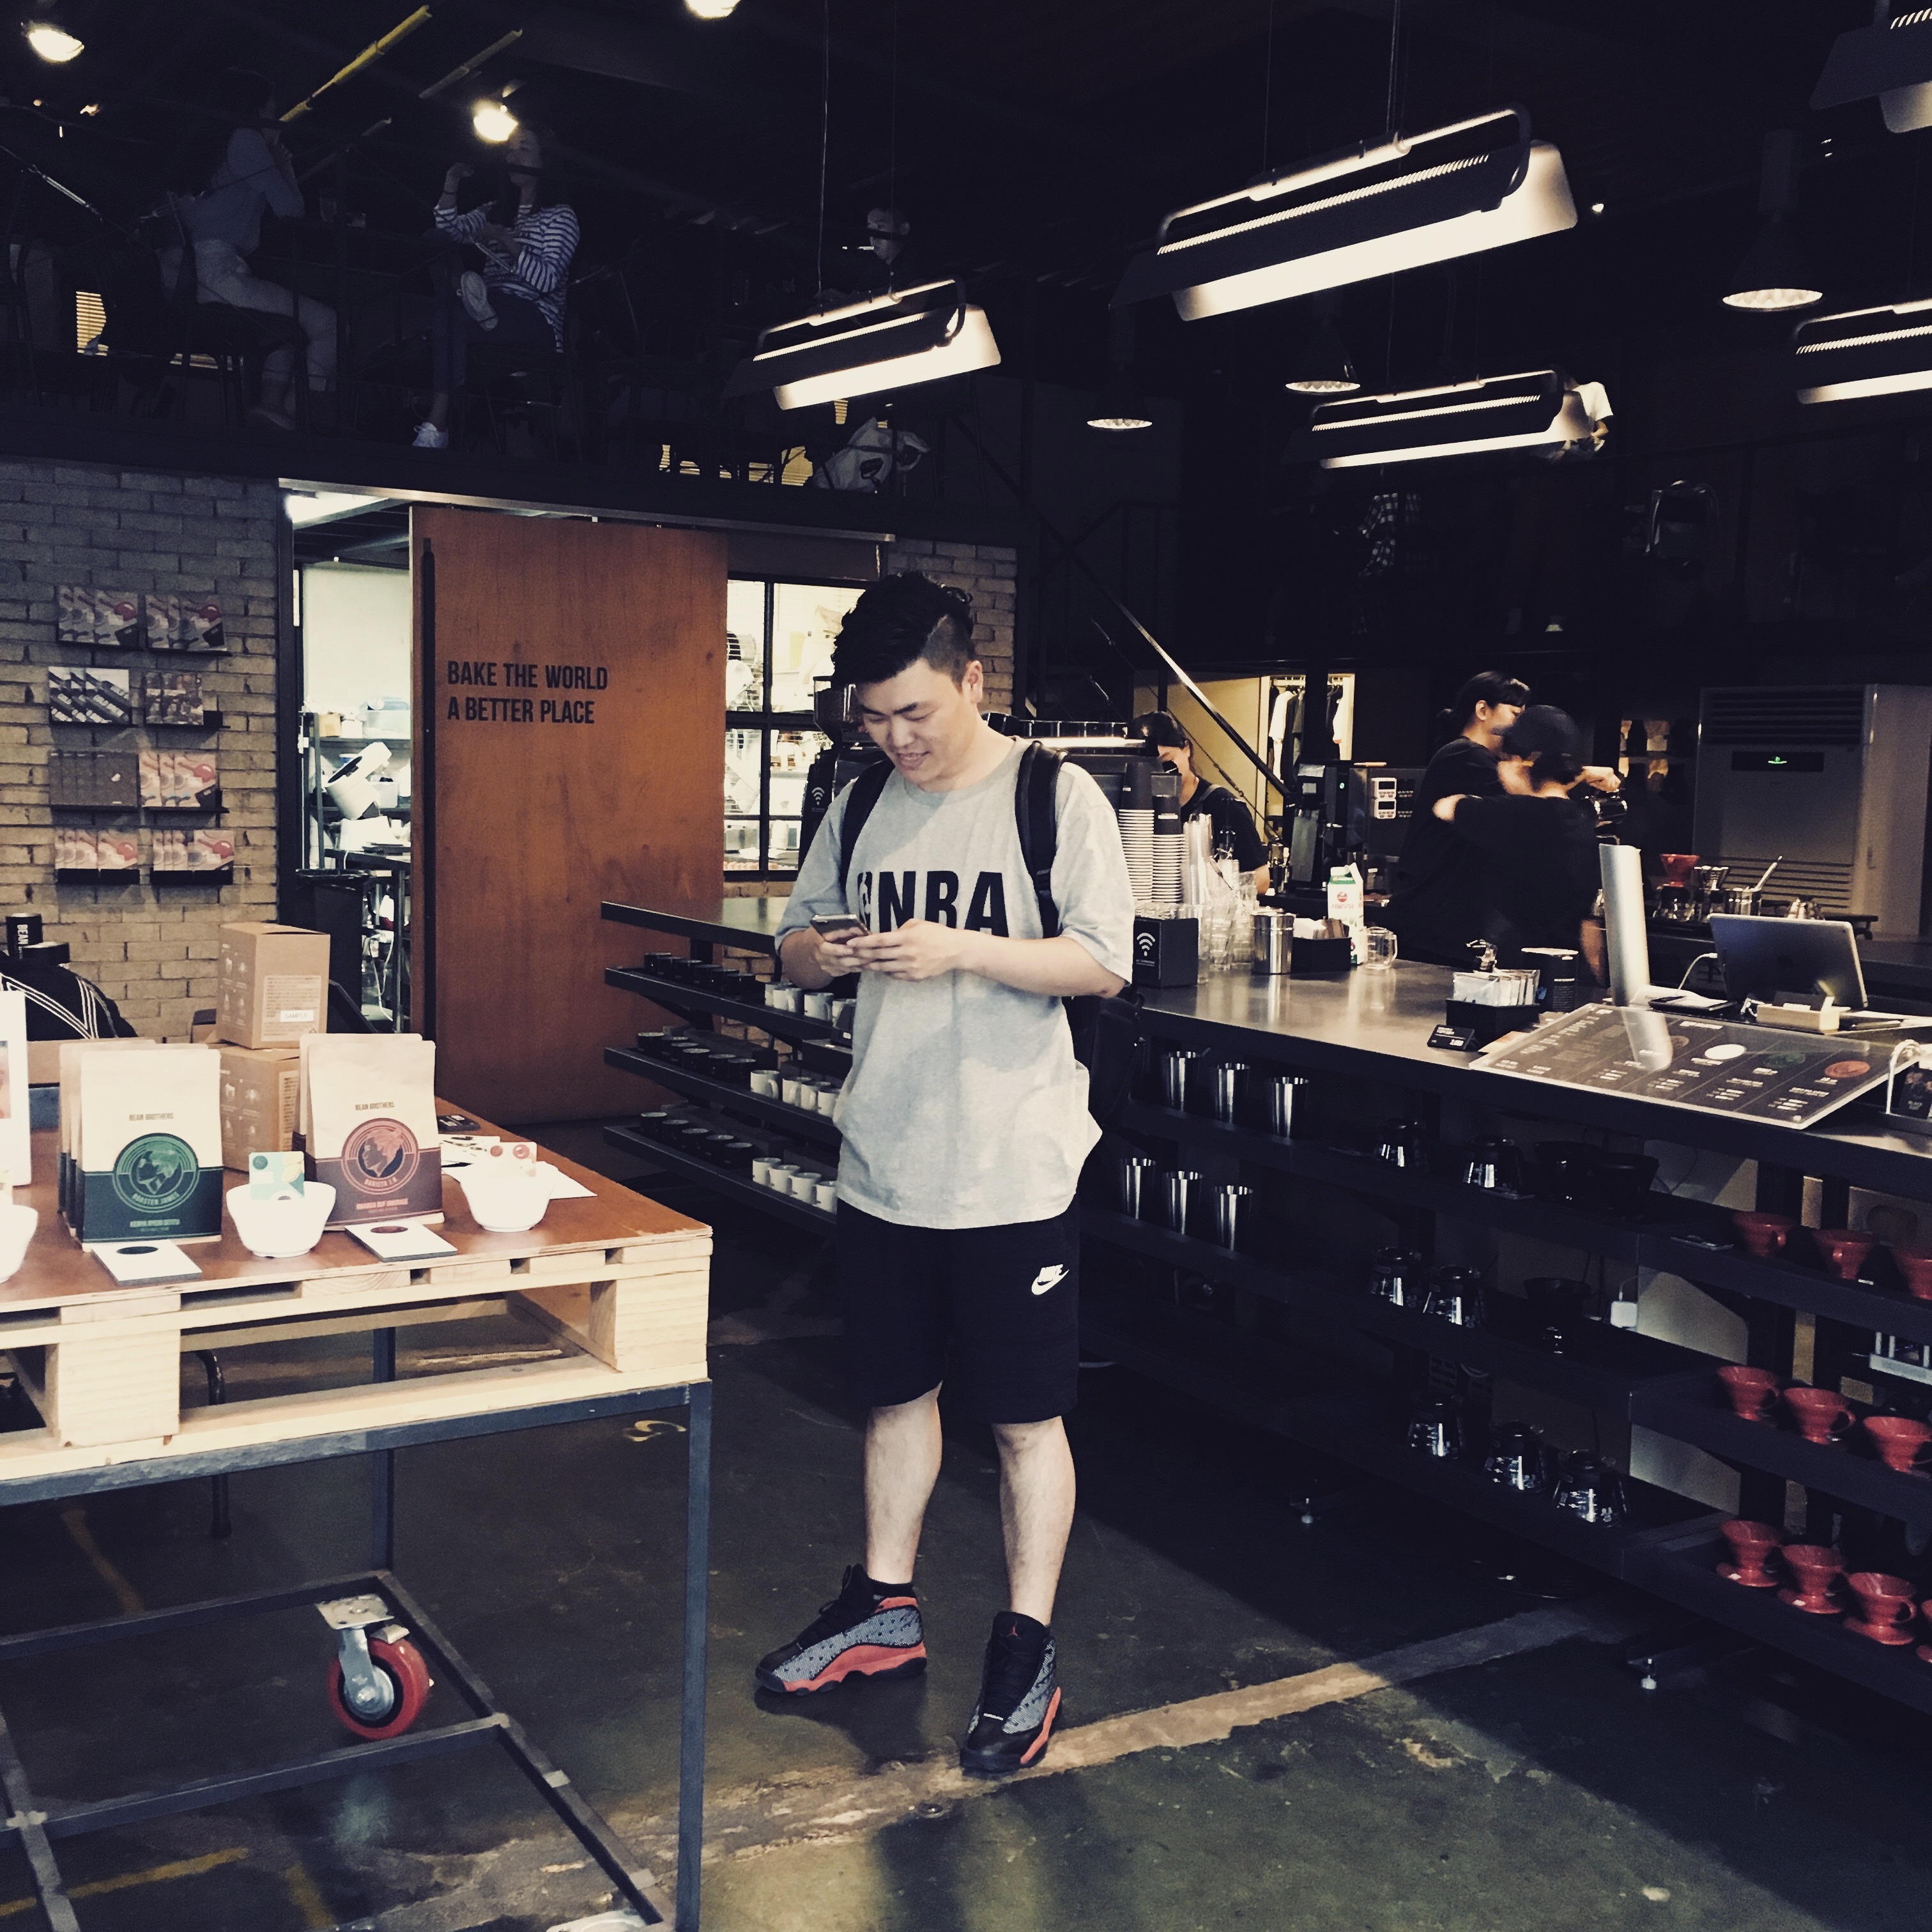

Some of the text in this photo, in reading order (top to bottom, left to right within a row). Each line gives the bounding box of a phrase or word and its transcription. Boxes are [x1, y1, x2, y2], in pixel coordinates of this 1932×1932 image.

[448, 660, 608, 690] BAKE THE WORLD
[447, 696, 595, 724] A BETTER PLACE
[878, 870, 1009, 938] NBA
[145, 1112, 174, 1121] BROTHERS
[370, 1101, 395, 1110] BROTHERS
